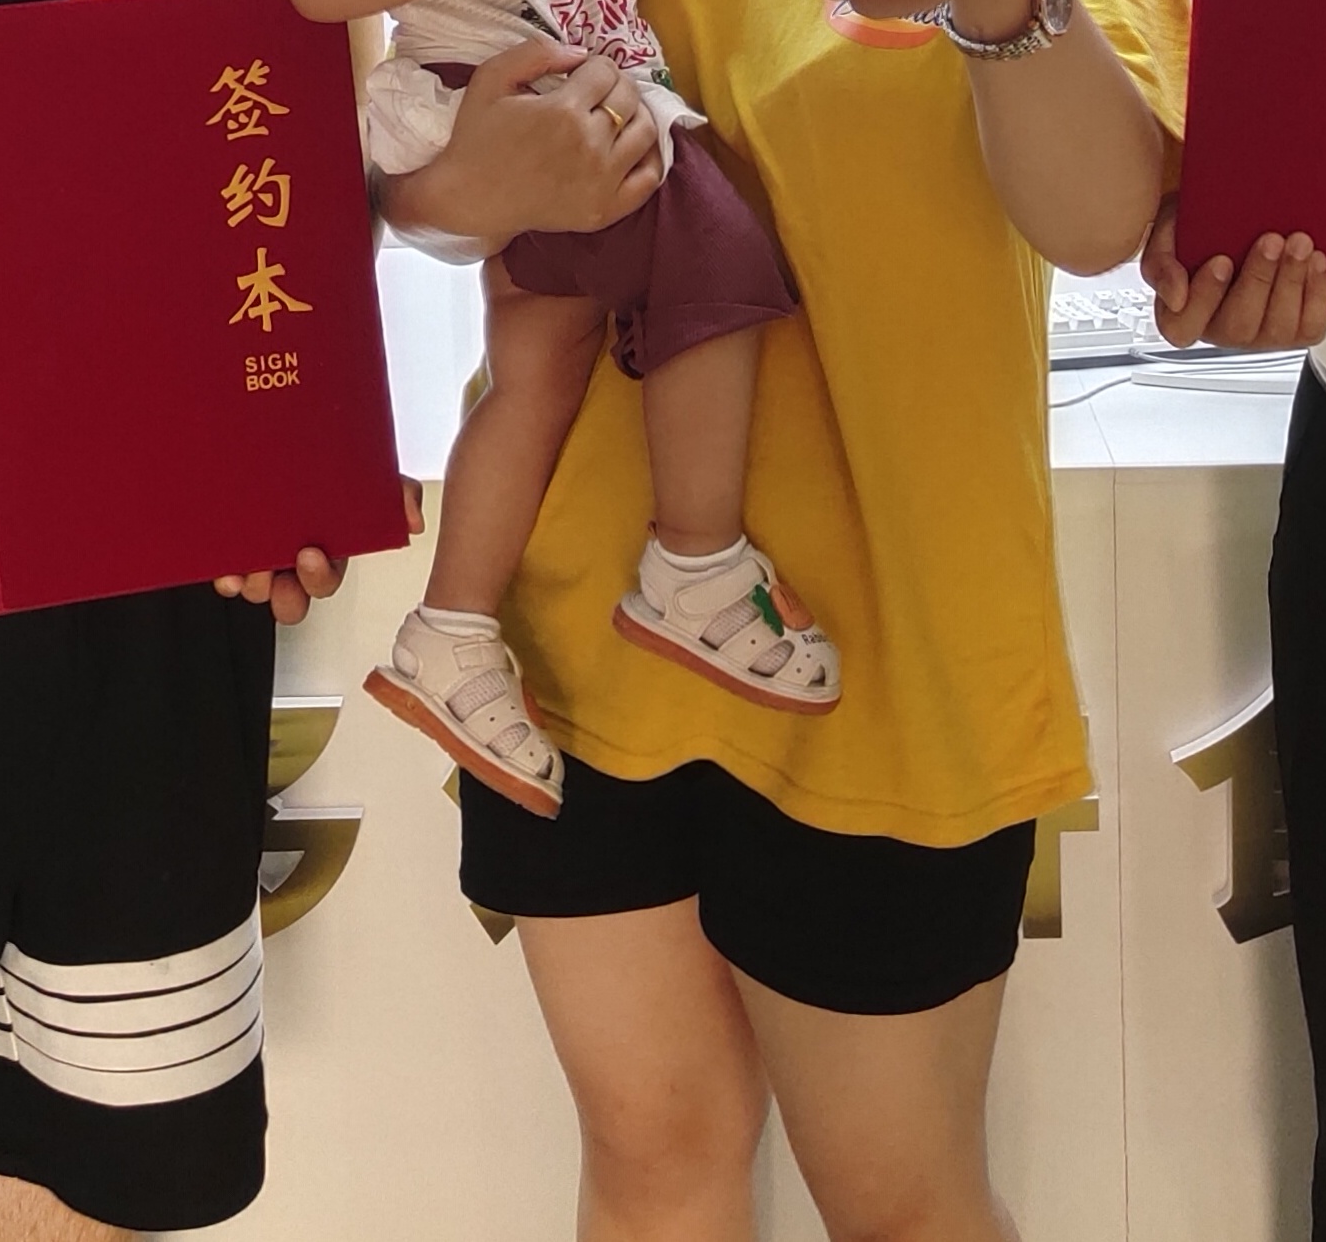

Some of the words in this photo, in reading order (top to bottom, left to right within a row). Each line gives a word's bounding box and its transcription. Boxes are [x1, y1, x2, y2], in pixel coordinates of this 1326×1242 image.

[205, 59, 313, 333] 签约本
[244, 352, 299, 373] SIGN
[245, 369, 301, 392] BOOK
